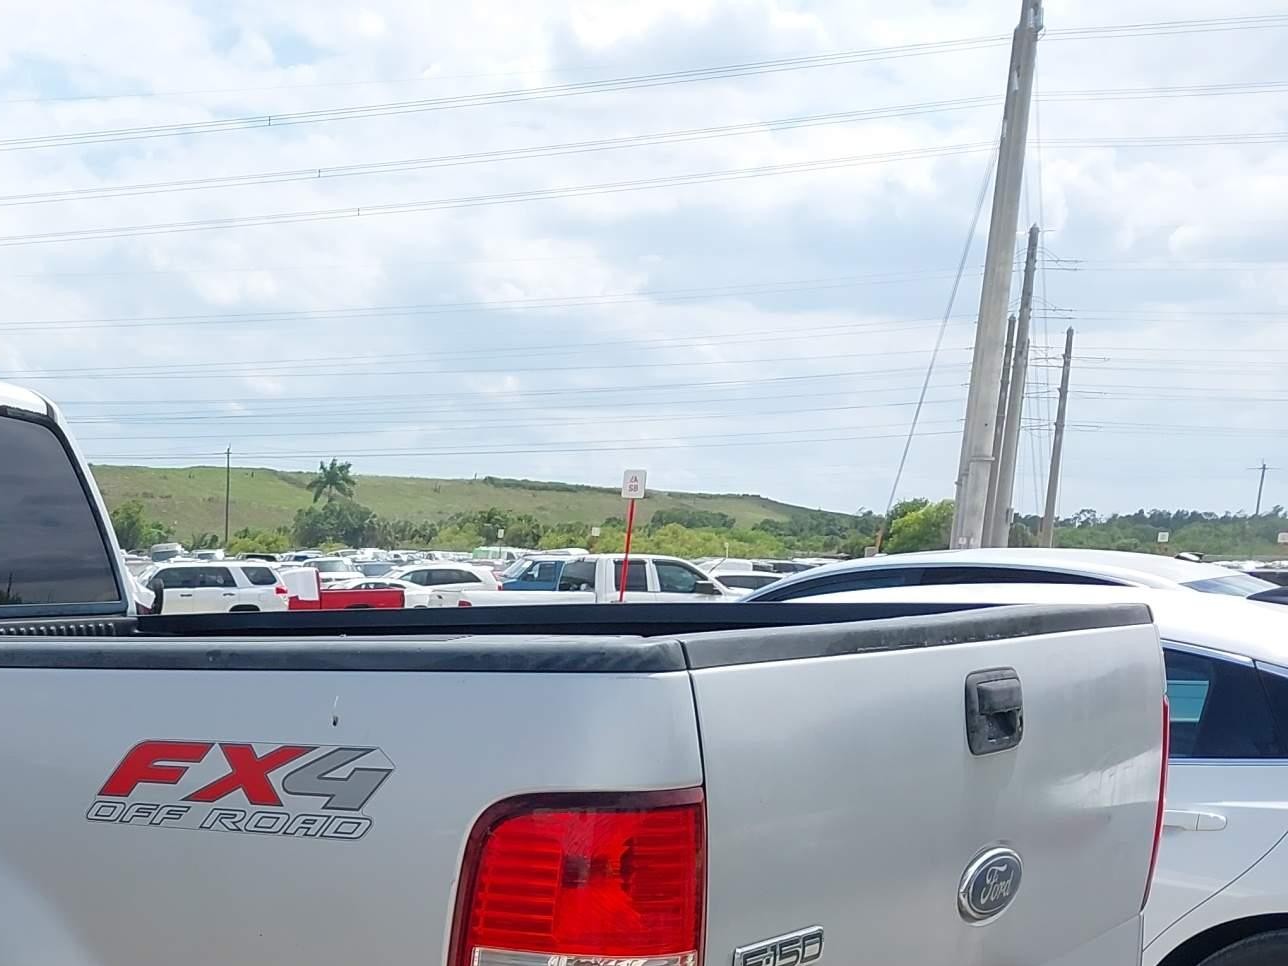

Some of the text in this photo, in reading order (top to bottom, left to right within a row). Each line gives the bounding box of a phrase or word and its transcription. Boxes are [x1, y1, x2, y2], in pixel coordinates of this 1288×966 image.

[96, 740, 395, 812] FX4
[86, 799, 374, 841] OFF ROAD
[980, 863, 1015, 905] Ford
